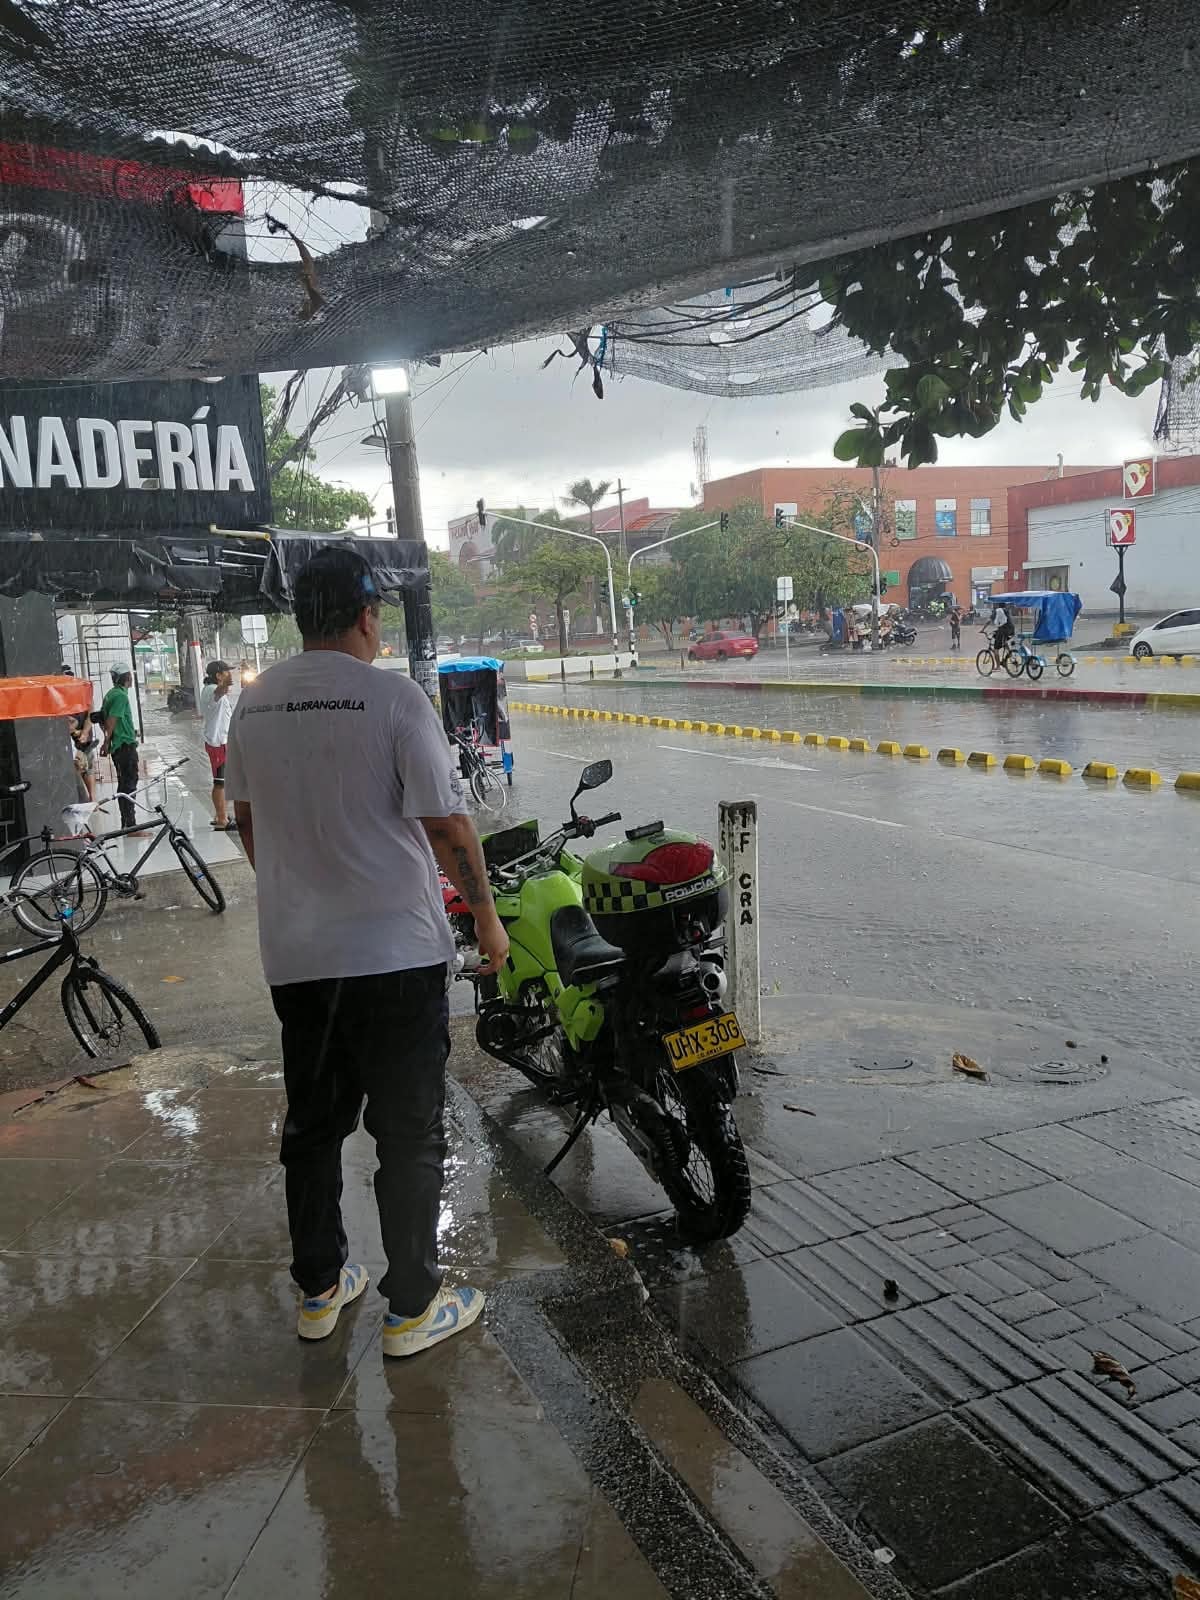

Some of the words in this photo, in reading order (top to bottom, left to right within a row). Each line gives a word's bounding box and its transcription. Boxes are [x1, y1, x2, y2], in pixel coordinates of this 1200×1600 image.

[0, 406, 255, 491] NADERÍA
[287, 700, 365, 712] BARRANQUILLA
[738, 872, 753, 926] CRA
